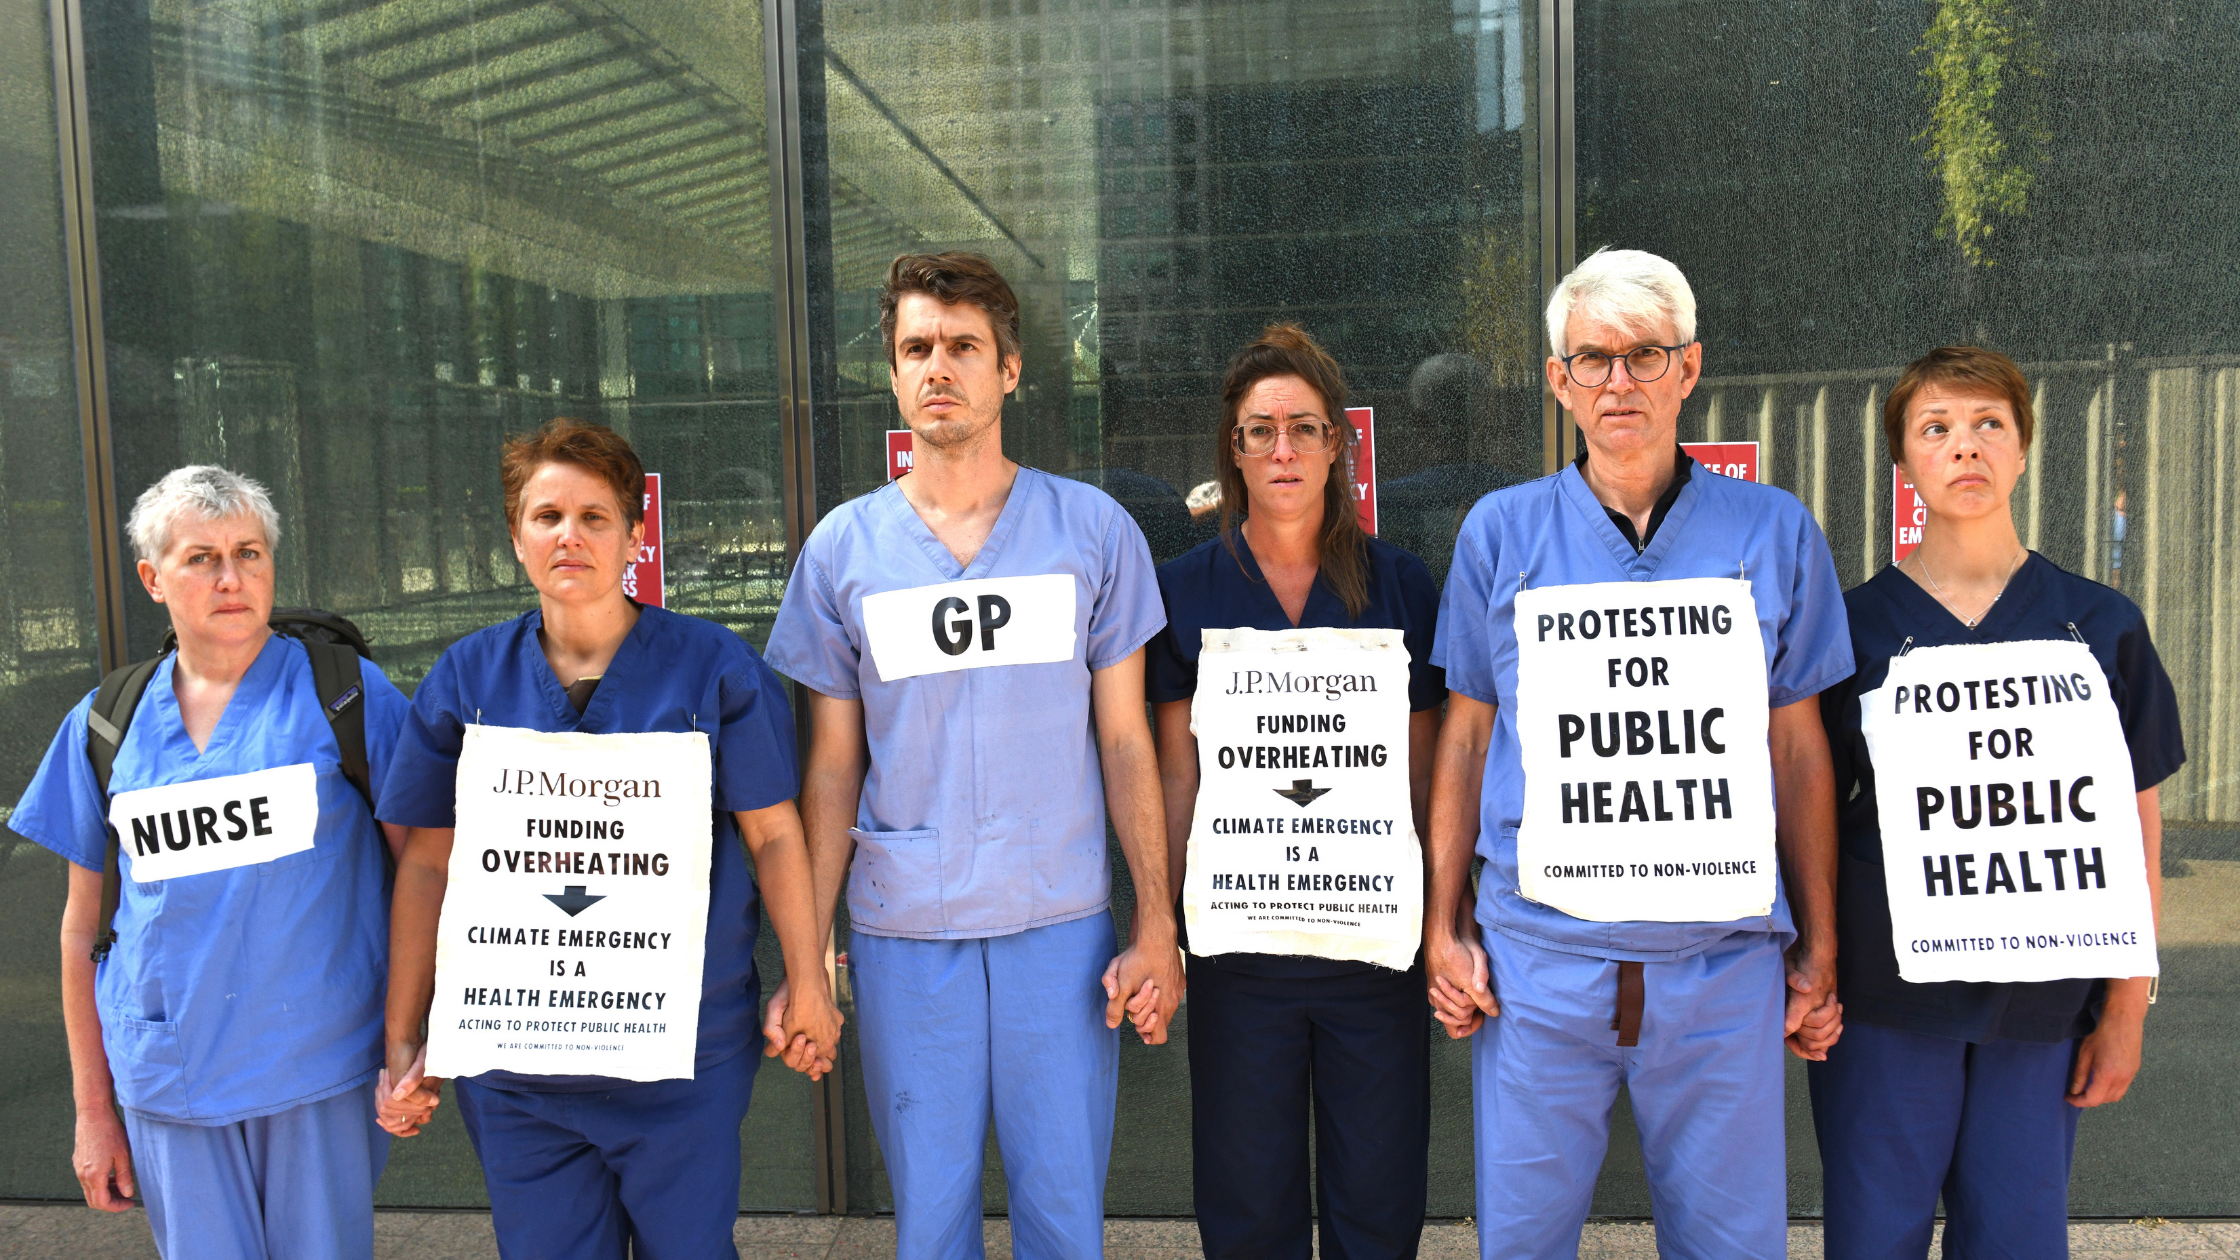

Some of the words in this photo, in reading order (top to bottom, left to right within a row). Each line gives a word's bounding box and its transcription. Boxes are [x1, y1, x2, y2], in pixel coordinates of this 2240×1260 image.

[932, 595, 1011, 655] GP
[1538, 605, 1731, 642] PROTESTING
[1608, 657, 1669, 687] FOR
[1226, 671, 1377, 701] J.P.Morgan
[1895, 673, 2091, 714] PROTESTING
[1257, 714, 1345, 734] FUNDING
[1559, 708, 1725, 758] PUBLIC
[1969, 728, 2034, 760] FOR
[1218, 744, 1387, 769] OVERHEATING
[493, 769, 661, 807] J.P.Morgan
[1561, 778, 1732, 823] HEALTH
[1917, 776, 2096, 830] PUBLIC
[131, 796, 272, 856] NURSE
[527, 819, 624, 839] FUNDING
[1213, 818, 1284, 834] CLIMATE
[1292, 818, 1393, 835] EMERGENCY
[482, 849, 669, 876] OVERHEATING
[1287, 846, 1300, 861] IS
[1308, 847, 1319, 861] A
[1544, 865, 1624, 877] COMMITTED
[1630, 864, 1648, 877] TO
[1654, 861, 1756, 876] NON-VIOLENCE
[1923, 847, 2106, 896] HEALTH
[1213, 874, 1279, 890] HEALTH
[1288, 874, 1394, 892] EMERGENCY
[1210, 901, 1248, 910] ACTING
[1252, 901, 1266, 910] TO
[1269, 902, 1314, 911] PROTECT
[1318, 903, 1354, 913] PUBLIC
[1358, 903, 1397, 914] HEALTH
[1271, 915, 1305, 923] COMMITTED
[1316, 918, 1360, 928] NON-VIOLENCE
[468, 927, 549, 945] CLIMATE
[558, 930, 671, 949] EMERGENCY
[1912, 938, 1994, 953] COMMITTED
[2001, 936, 2019, 949] TO
[2026, 932, 2137, 948] NON-VIOLENCE
[550, 960, 565, 976] IS
[574, 961, 585, 976] A
[464, 988, 540, 1006] HEALTH
[549, 990, 666, 1010] EMERGENCY
[459, 1019, 501, 1030] ACTING
[507, 1020, 521, 1030] TO
[526, 1021, 576, 1032] PROTECT
[581, 1022, 619, 1033] PUBLIC
[624, 1023, 666, 1033] HEALTH
[496, 1041, 507, 1050] WE
[509, 1042, 522, 1050] ARE
[523, 1042, 562, 1051] COMMITTED
[564, 1043, 573, 1051] TO
[575, 1043, 624, 1052] NON-VIOLENCE
